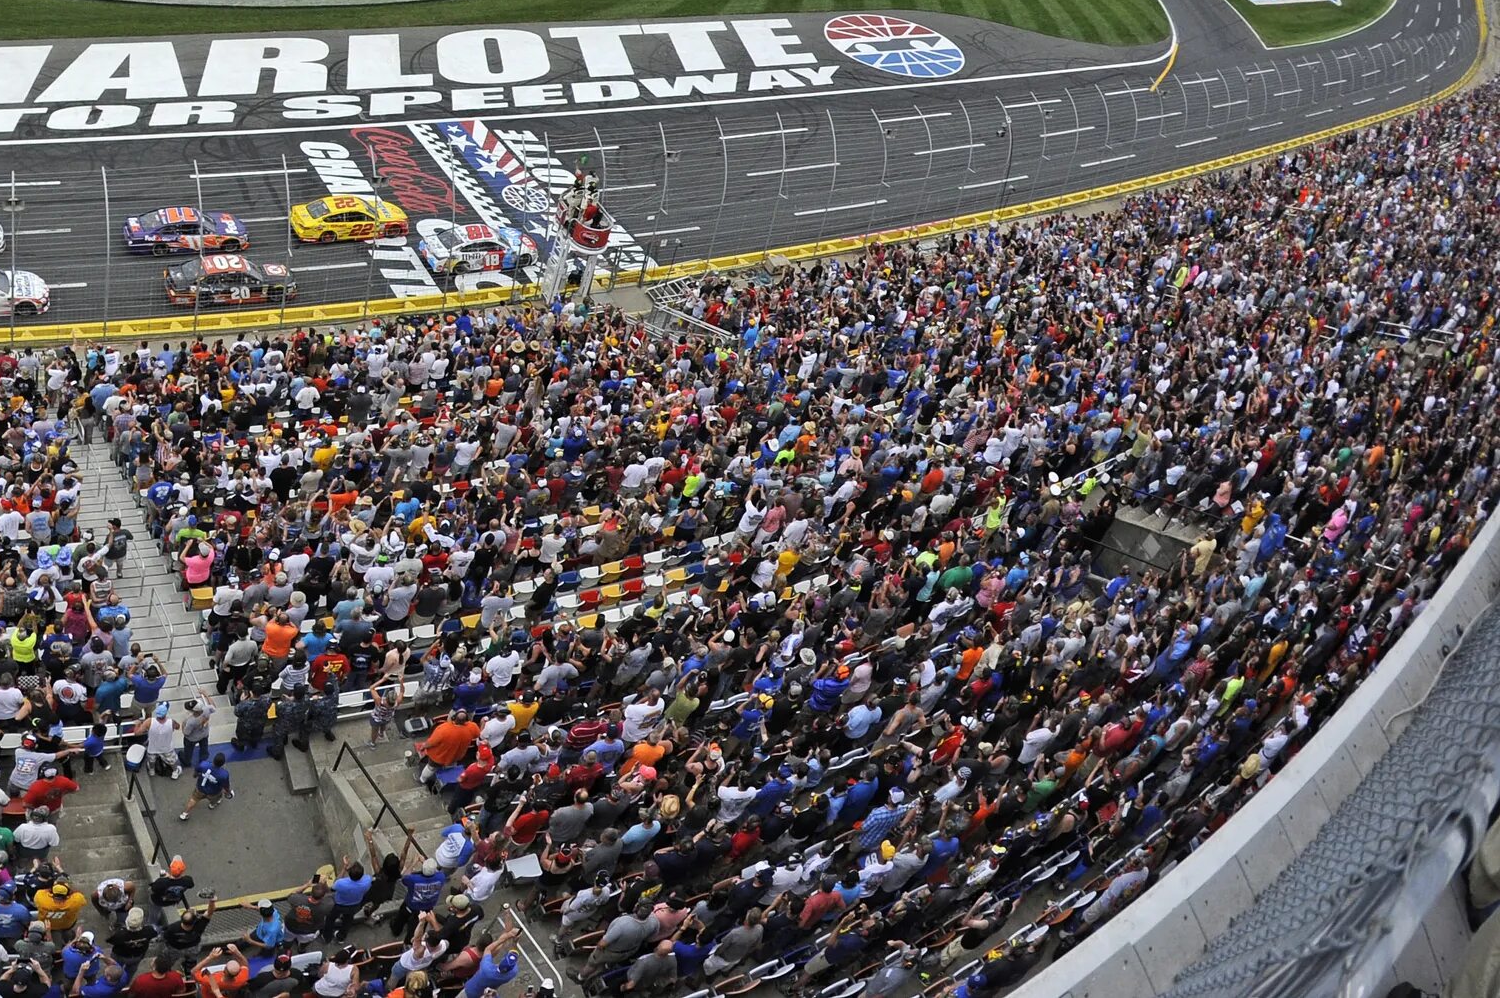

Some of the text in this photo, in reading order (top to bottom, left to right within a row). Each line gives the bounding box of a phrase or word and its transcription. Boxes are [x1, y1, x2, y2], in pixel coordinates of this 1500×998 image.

[282, 65, 841, 120] SPEEDWAY
[333, 197, 359, 210] 22
[165, 206, 198, 224] 11
[348, 223, 374, 237] 22
[465, 225, 493, 240] 18
[212, 254, 242, 270] 20
[484, 253, 500, 266] 18
[230, 286, 250, 300] 20
